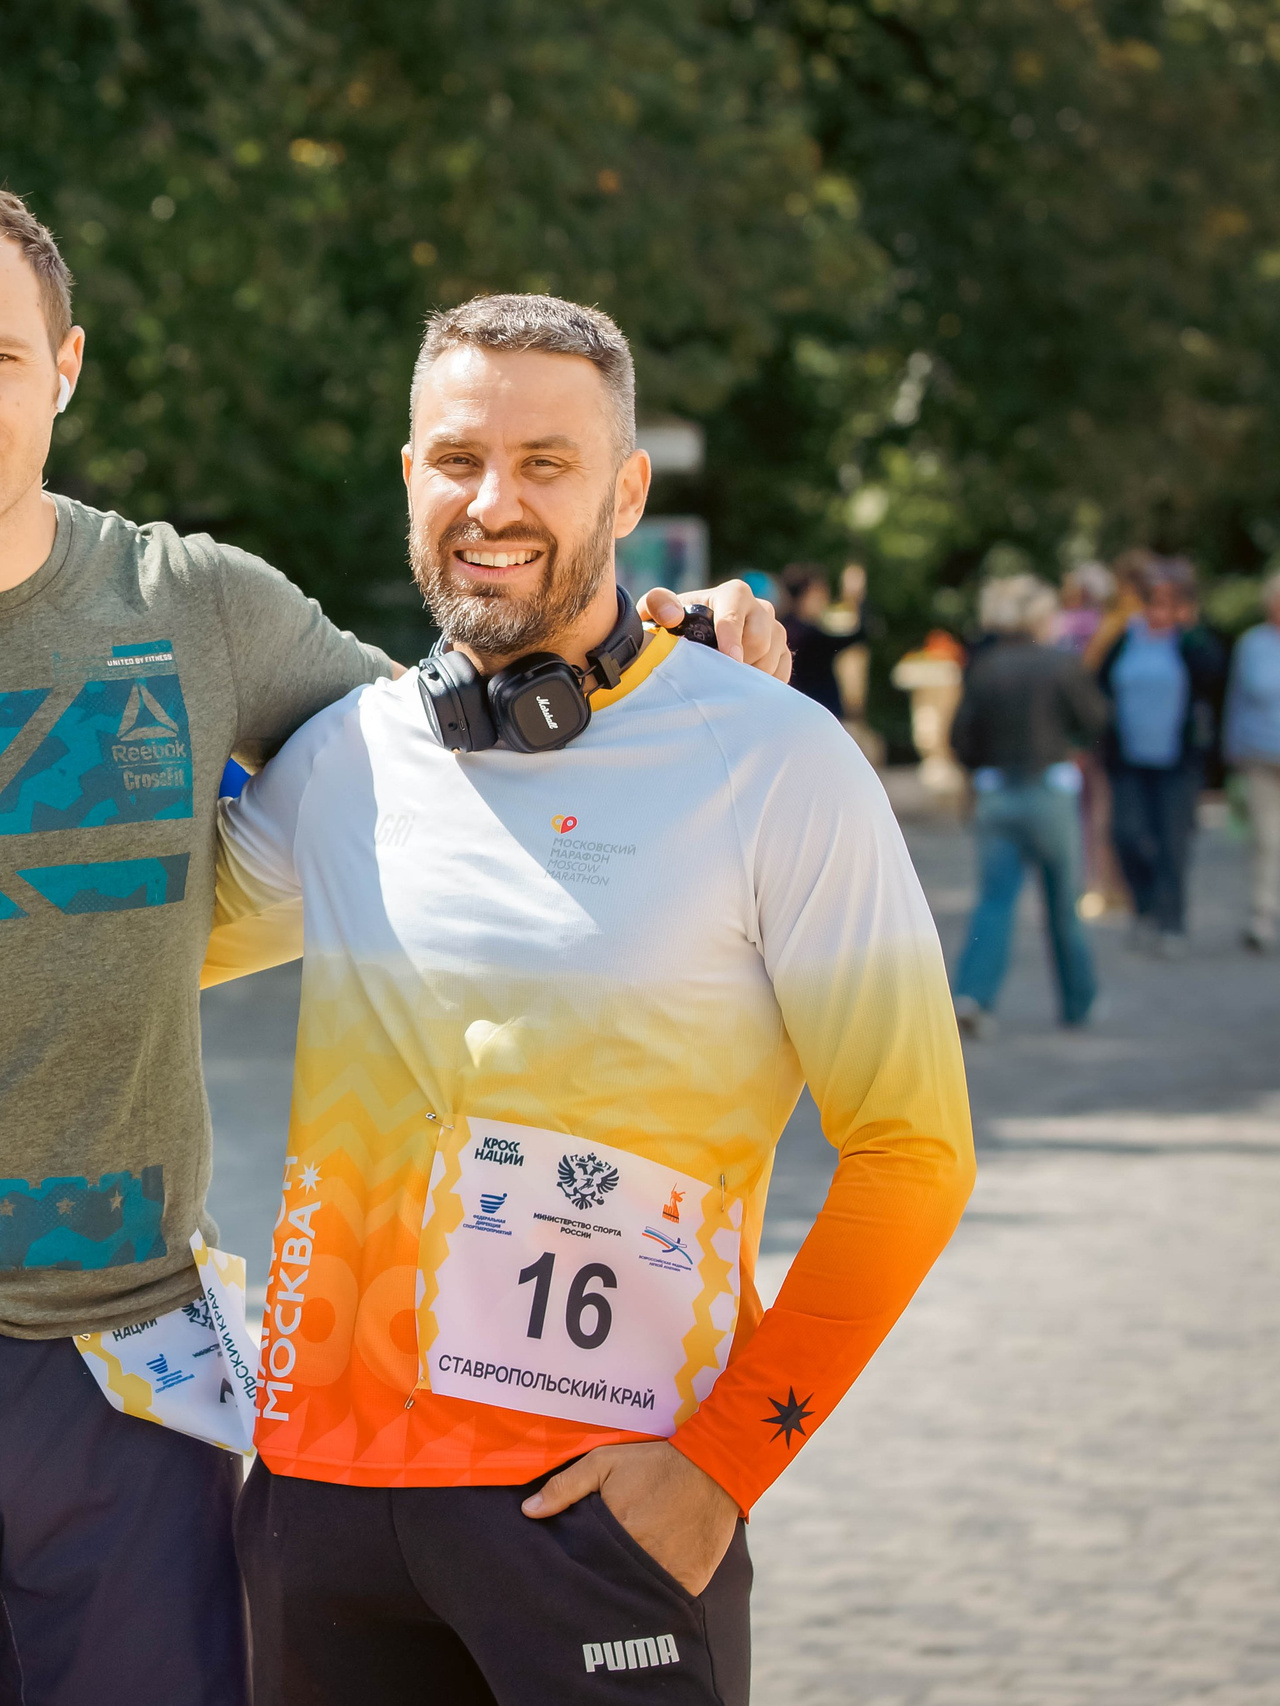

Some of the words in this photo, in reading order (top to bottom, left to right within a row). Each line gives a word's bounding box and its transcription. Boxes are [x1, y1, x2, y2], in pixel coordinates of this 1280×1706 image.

[106, 657, 133, 666] UNITED
[145, 653, 173, 662] FITNESS
[536, 695, 559, 730] Marshall
[111, 740, 187, 763] Reebok
[123, 766, 185, 791] CrossFit
[549, 847, 610, 865] МАРАФОН
[552, 837, 637, 856] МОСКОВСКИЙ
[544, 869, 610, 886] MARATHON
[546, 858, 601, 874] MOSCOW
[483, 1136, 520, 1153] КРОСС
[474, 1147, 525, 1167] НАЦИИ
[533, 1212, 591, 1230] МИНИСТЕРСТВО
[592, 1225, 622, 1237] СПОРТА
[560, 1227, 591, 1239] РОССИИ
[262, 1200, 322, 1422] МОСКВА
[518, 1251, 618, 1350] 16
[112, 1317, 158, 1342] НАЦИИ
[438, 1353, 607, 1402] СТАВРОПОЛЬСКИЙ
[610, 1386, 656, 1410] КРАЙ
[582, 1633, 680, 1673] PUMA
